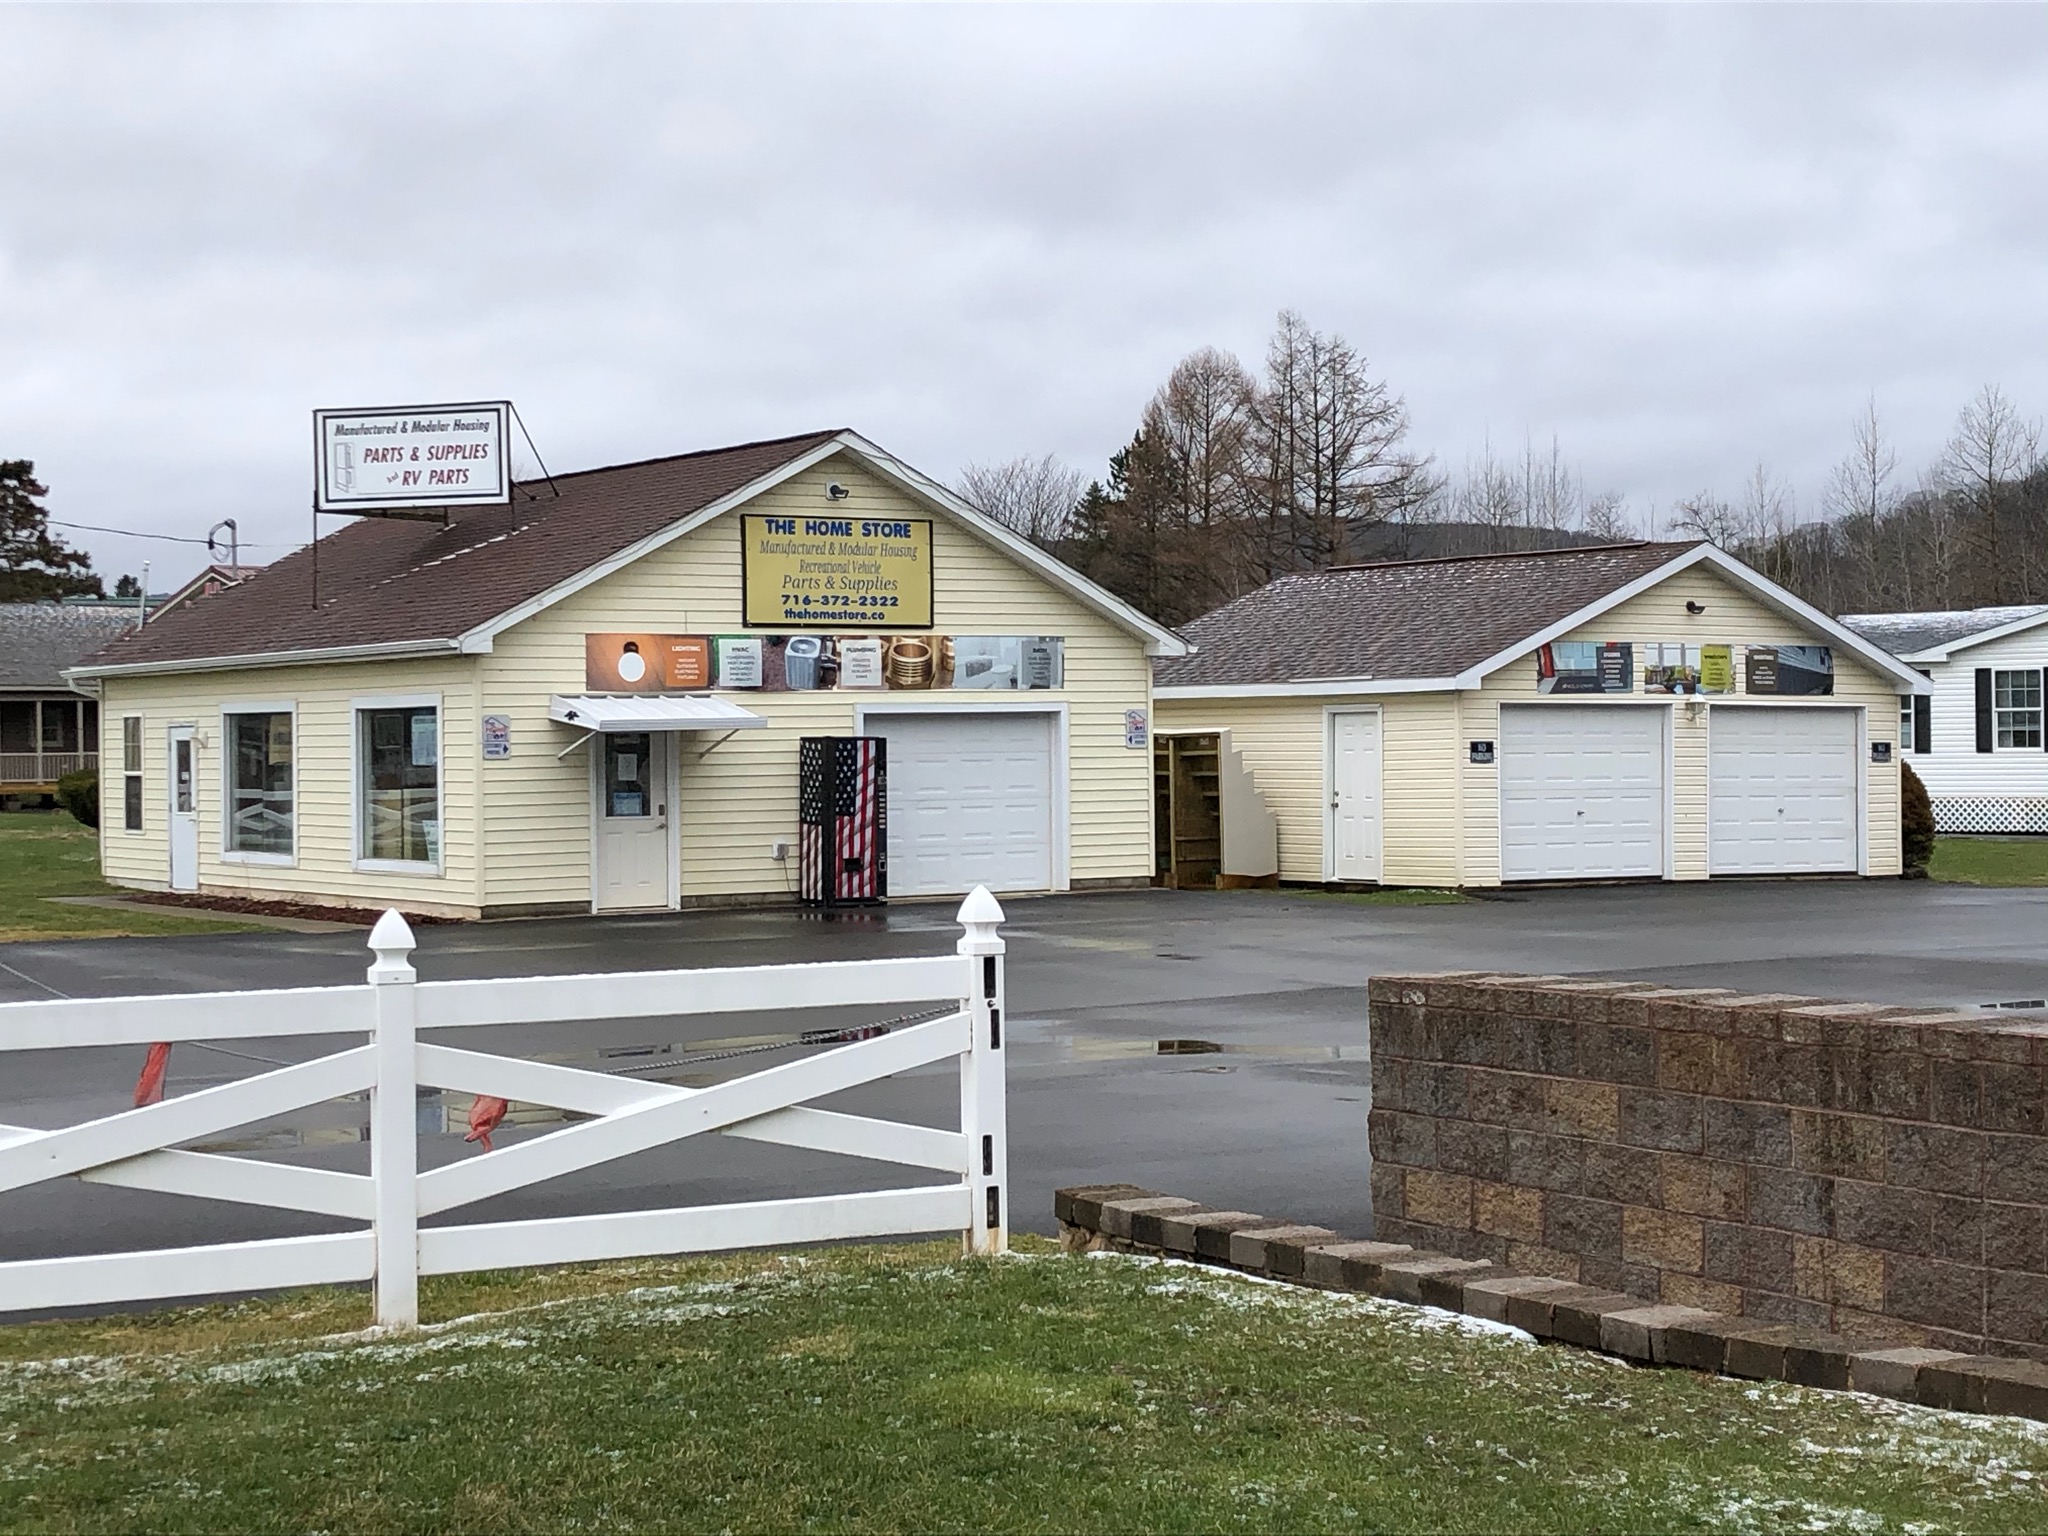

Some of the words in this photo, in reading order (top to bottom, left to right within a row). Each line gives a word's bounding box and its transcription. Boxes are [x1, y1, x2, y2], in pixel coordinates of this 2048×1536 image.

[334, 421, 398, 436] Manufactured
[401, 421, 408, 434] &
[411, 420, 450, 433] Modular
[453, 419, 490, 433] Housing
[363, 447, 405, 463] PARTS
[410, 447, 420, 461] &
[426, 443, 489, 461] SUPPLIES
[402, 470, 422, 486] RV
[428, 468, 470, 485] PARTS
[765, 519, 796, 535] THE
[805, 520, 853, 536] HOME
[861, 522, 911, 538] STORE
[759, 539, 827, 558] Manufactured
[828, 541, 837, 555] &
[838, 542, 878, 556] Modular
[880, 543, 918, 561] Housing
[799, 559, 850, 574] Recreational
[852, 560, 881, 575] Vehicle
[782, 574, 821, 589] Parts
[824, 575, 835, 589] &
[839, 575, 898, 594] Supplies
[781, 594, 899, 606] 716-372-2322
[784, 608, 885, 620] thehomestore.co
